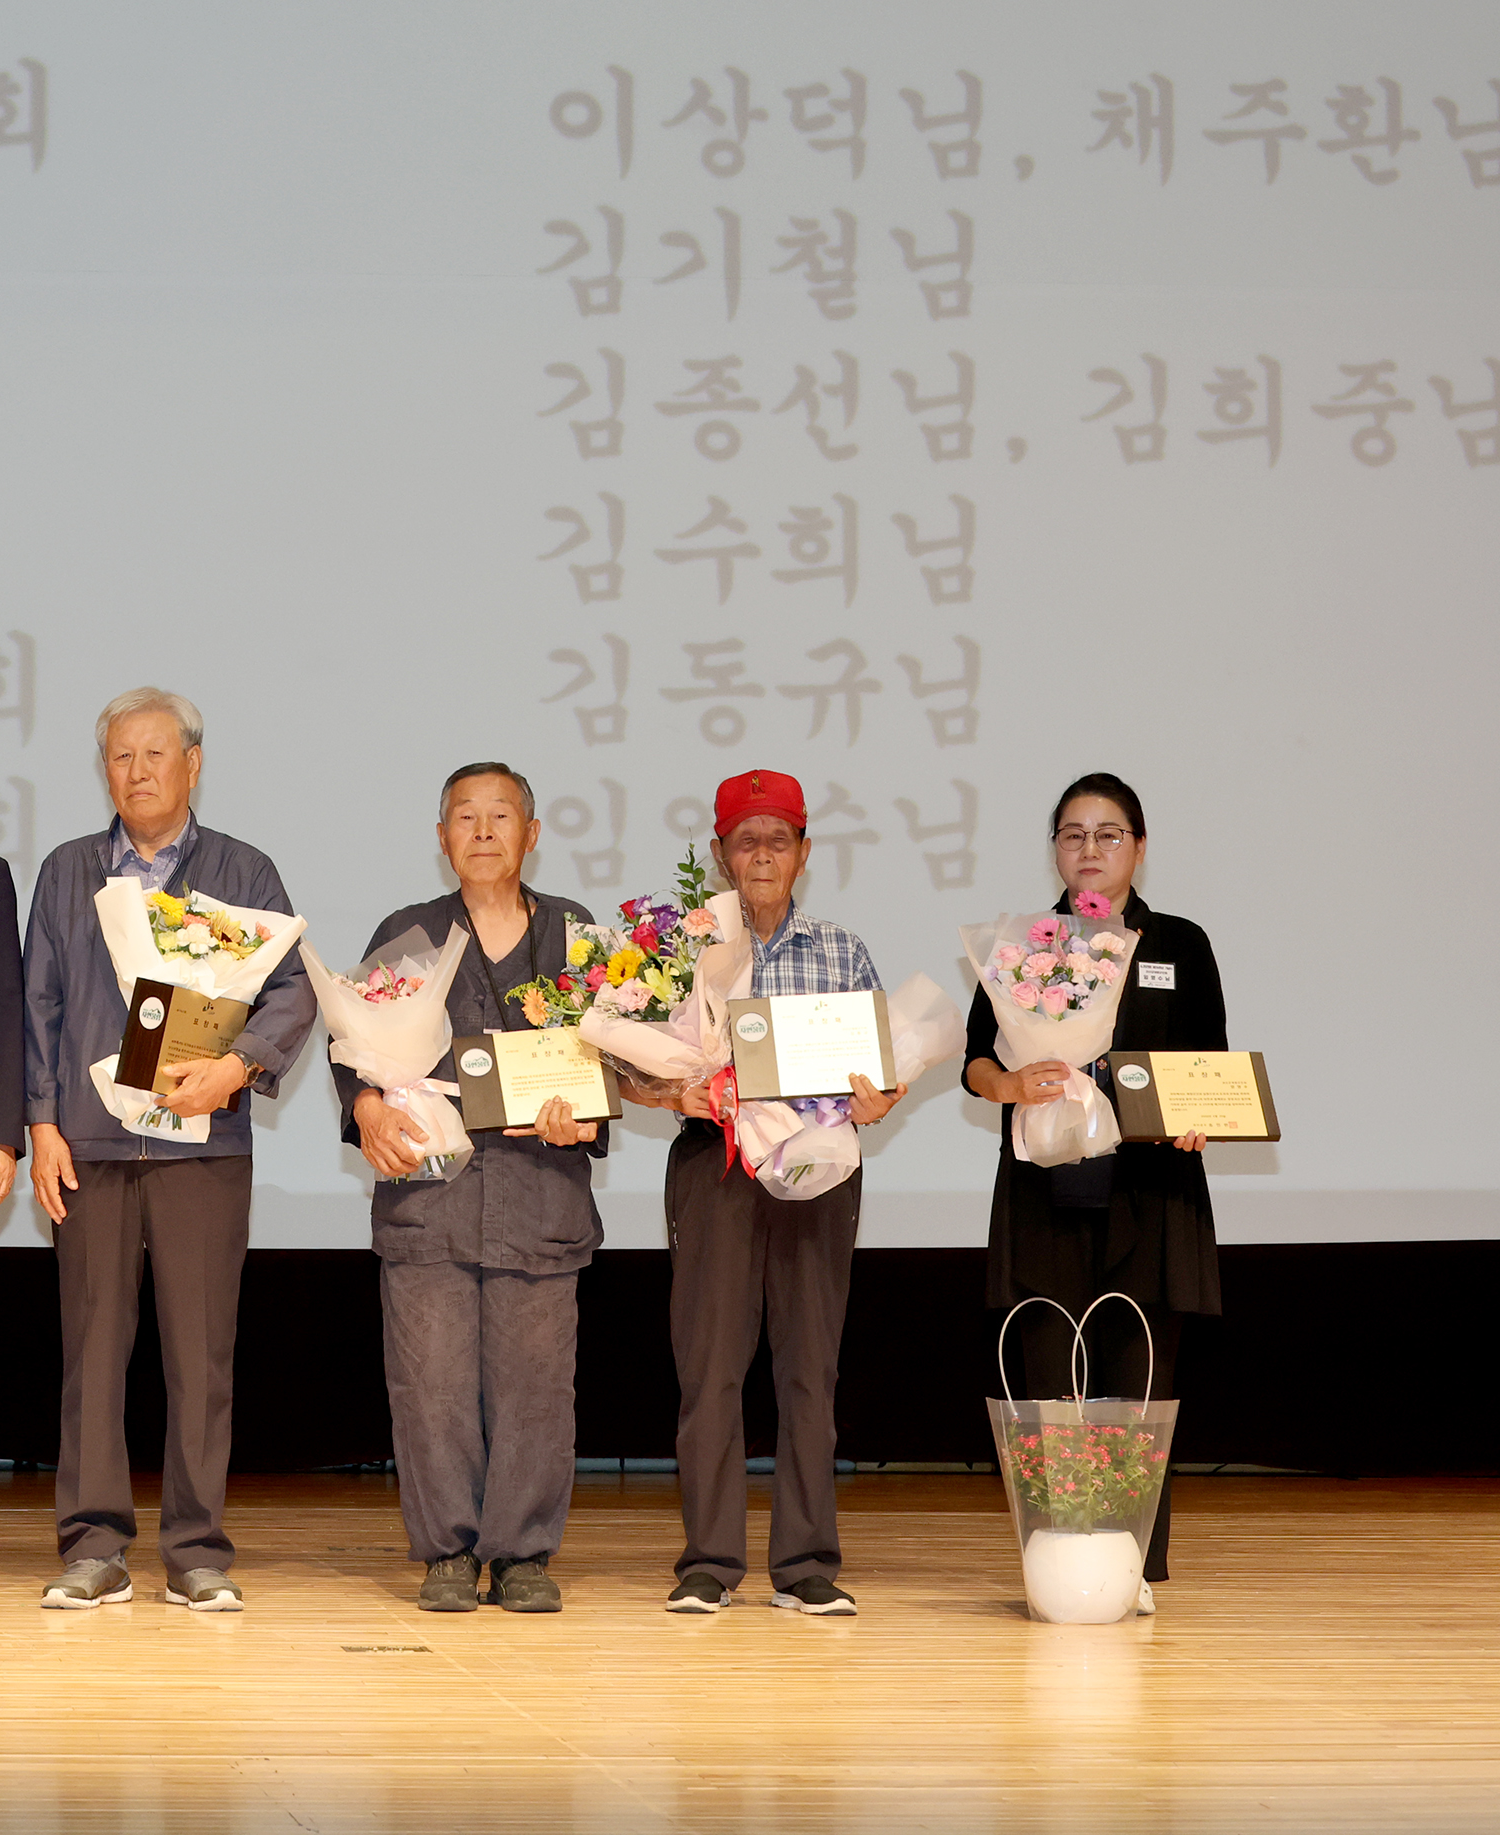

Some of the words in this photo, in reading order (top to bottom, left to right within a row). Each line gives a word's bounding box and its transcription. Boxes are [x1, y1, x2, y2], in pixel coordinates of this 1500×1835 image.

[550, 64, 1036, 182] 이상덕님,
[1092, 73, 1500, 190] 채주환님
[538, 205, 975, 321] 김기철님
[540, 347, 1028, 464] 김종선님,
[1086, 353, 1500, 470] 김희중님
[539, 491, 976, 606] 김수희님
[544, 633, 981, 747] 김동규님
